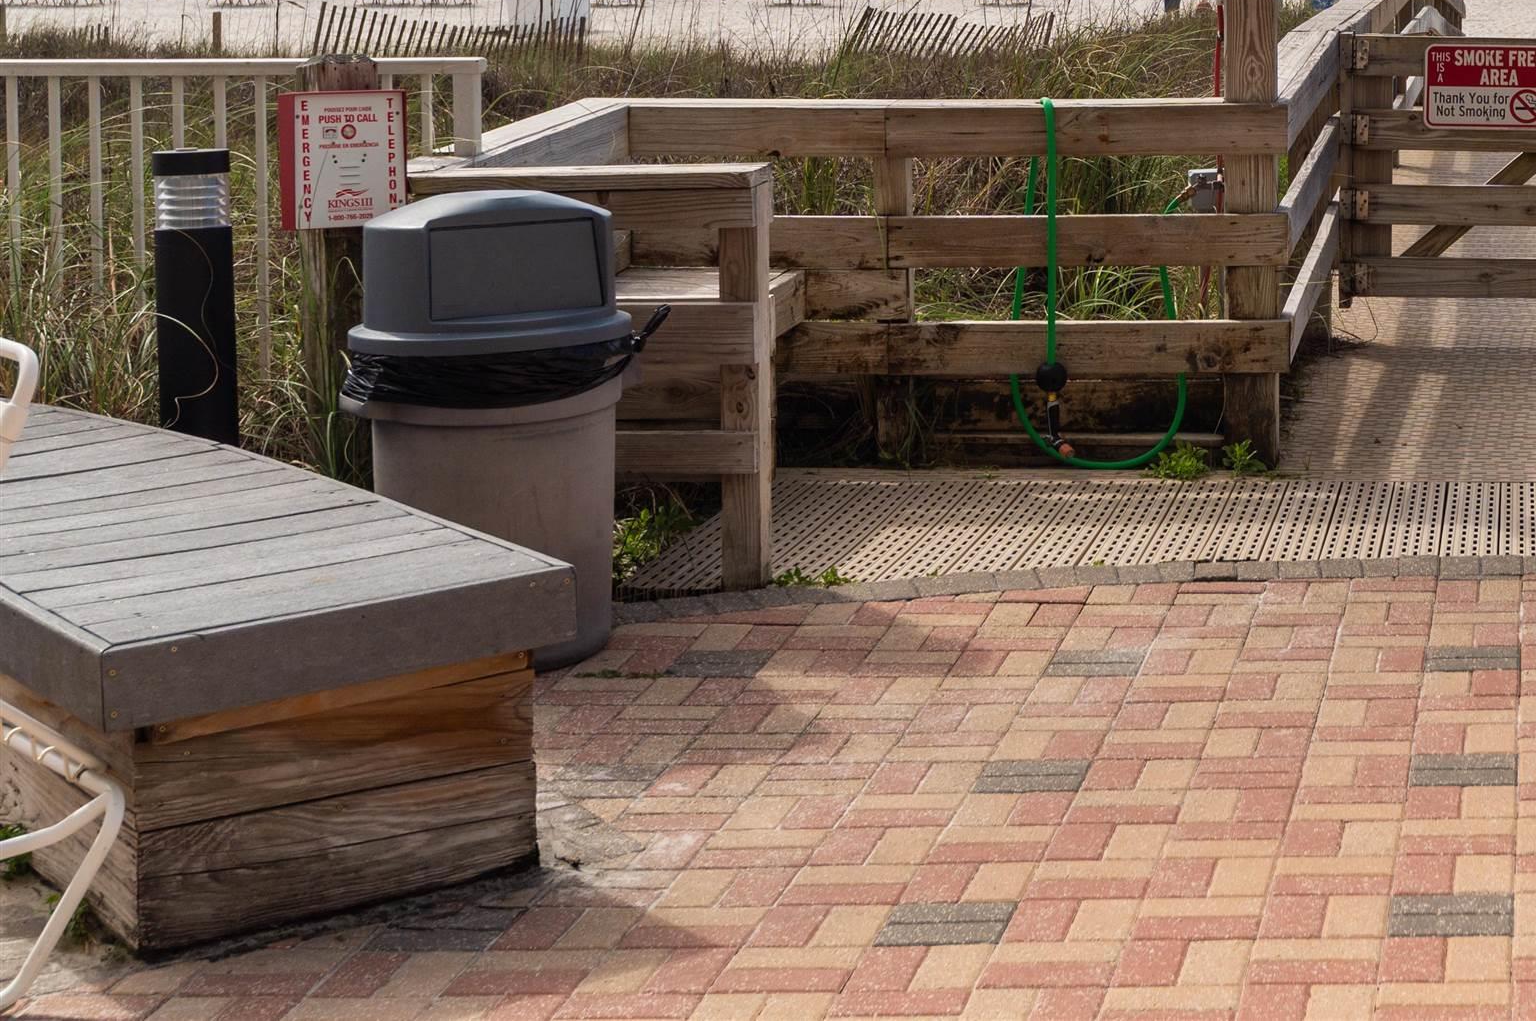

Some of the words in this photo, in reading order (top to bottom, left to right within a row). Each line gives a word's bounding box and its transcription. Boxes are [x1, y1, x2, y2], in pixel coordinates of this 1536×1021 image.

[1431, 51, 1451, 62] THIS
[1454, 49, 1504, 67] SMOKE
[1436, 62, 1445, 73] IS
[1437, 73, 1444, 83] A
[1479, 68, 1519, 86] AREA
[1433, 91, 1465, 104] Thank
[1469, 92, 1490, 105] You
[1493, 92, 1510, 105] for
[319, 114, 342, 124] PUSH
[343, 114, 355, 123] TO
[357, 113, 378, 123] CALL
[1436, 105, 1455, 117] Not
[1459, 105, 1506, 120] Smoking
[301, 100, 312, 222] EMERGENCY
[386, 98, 397, 211] TELEPHON
